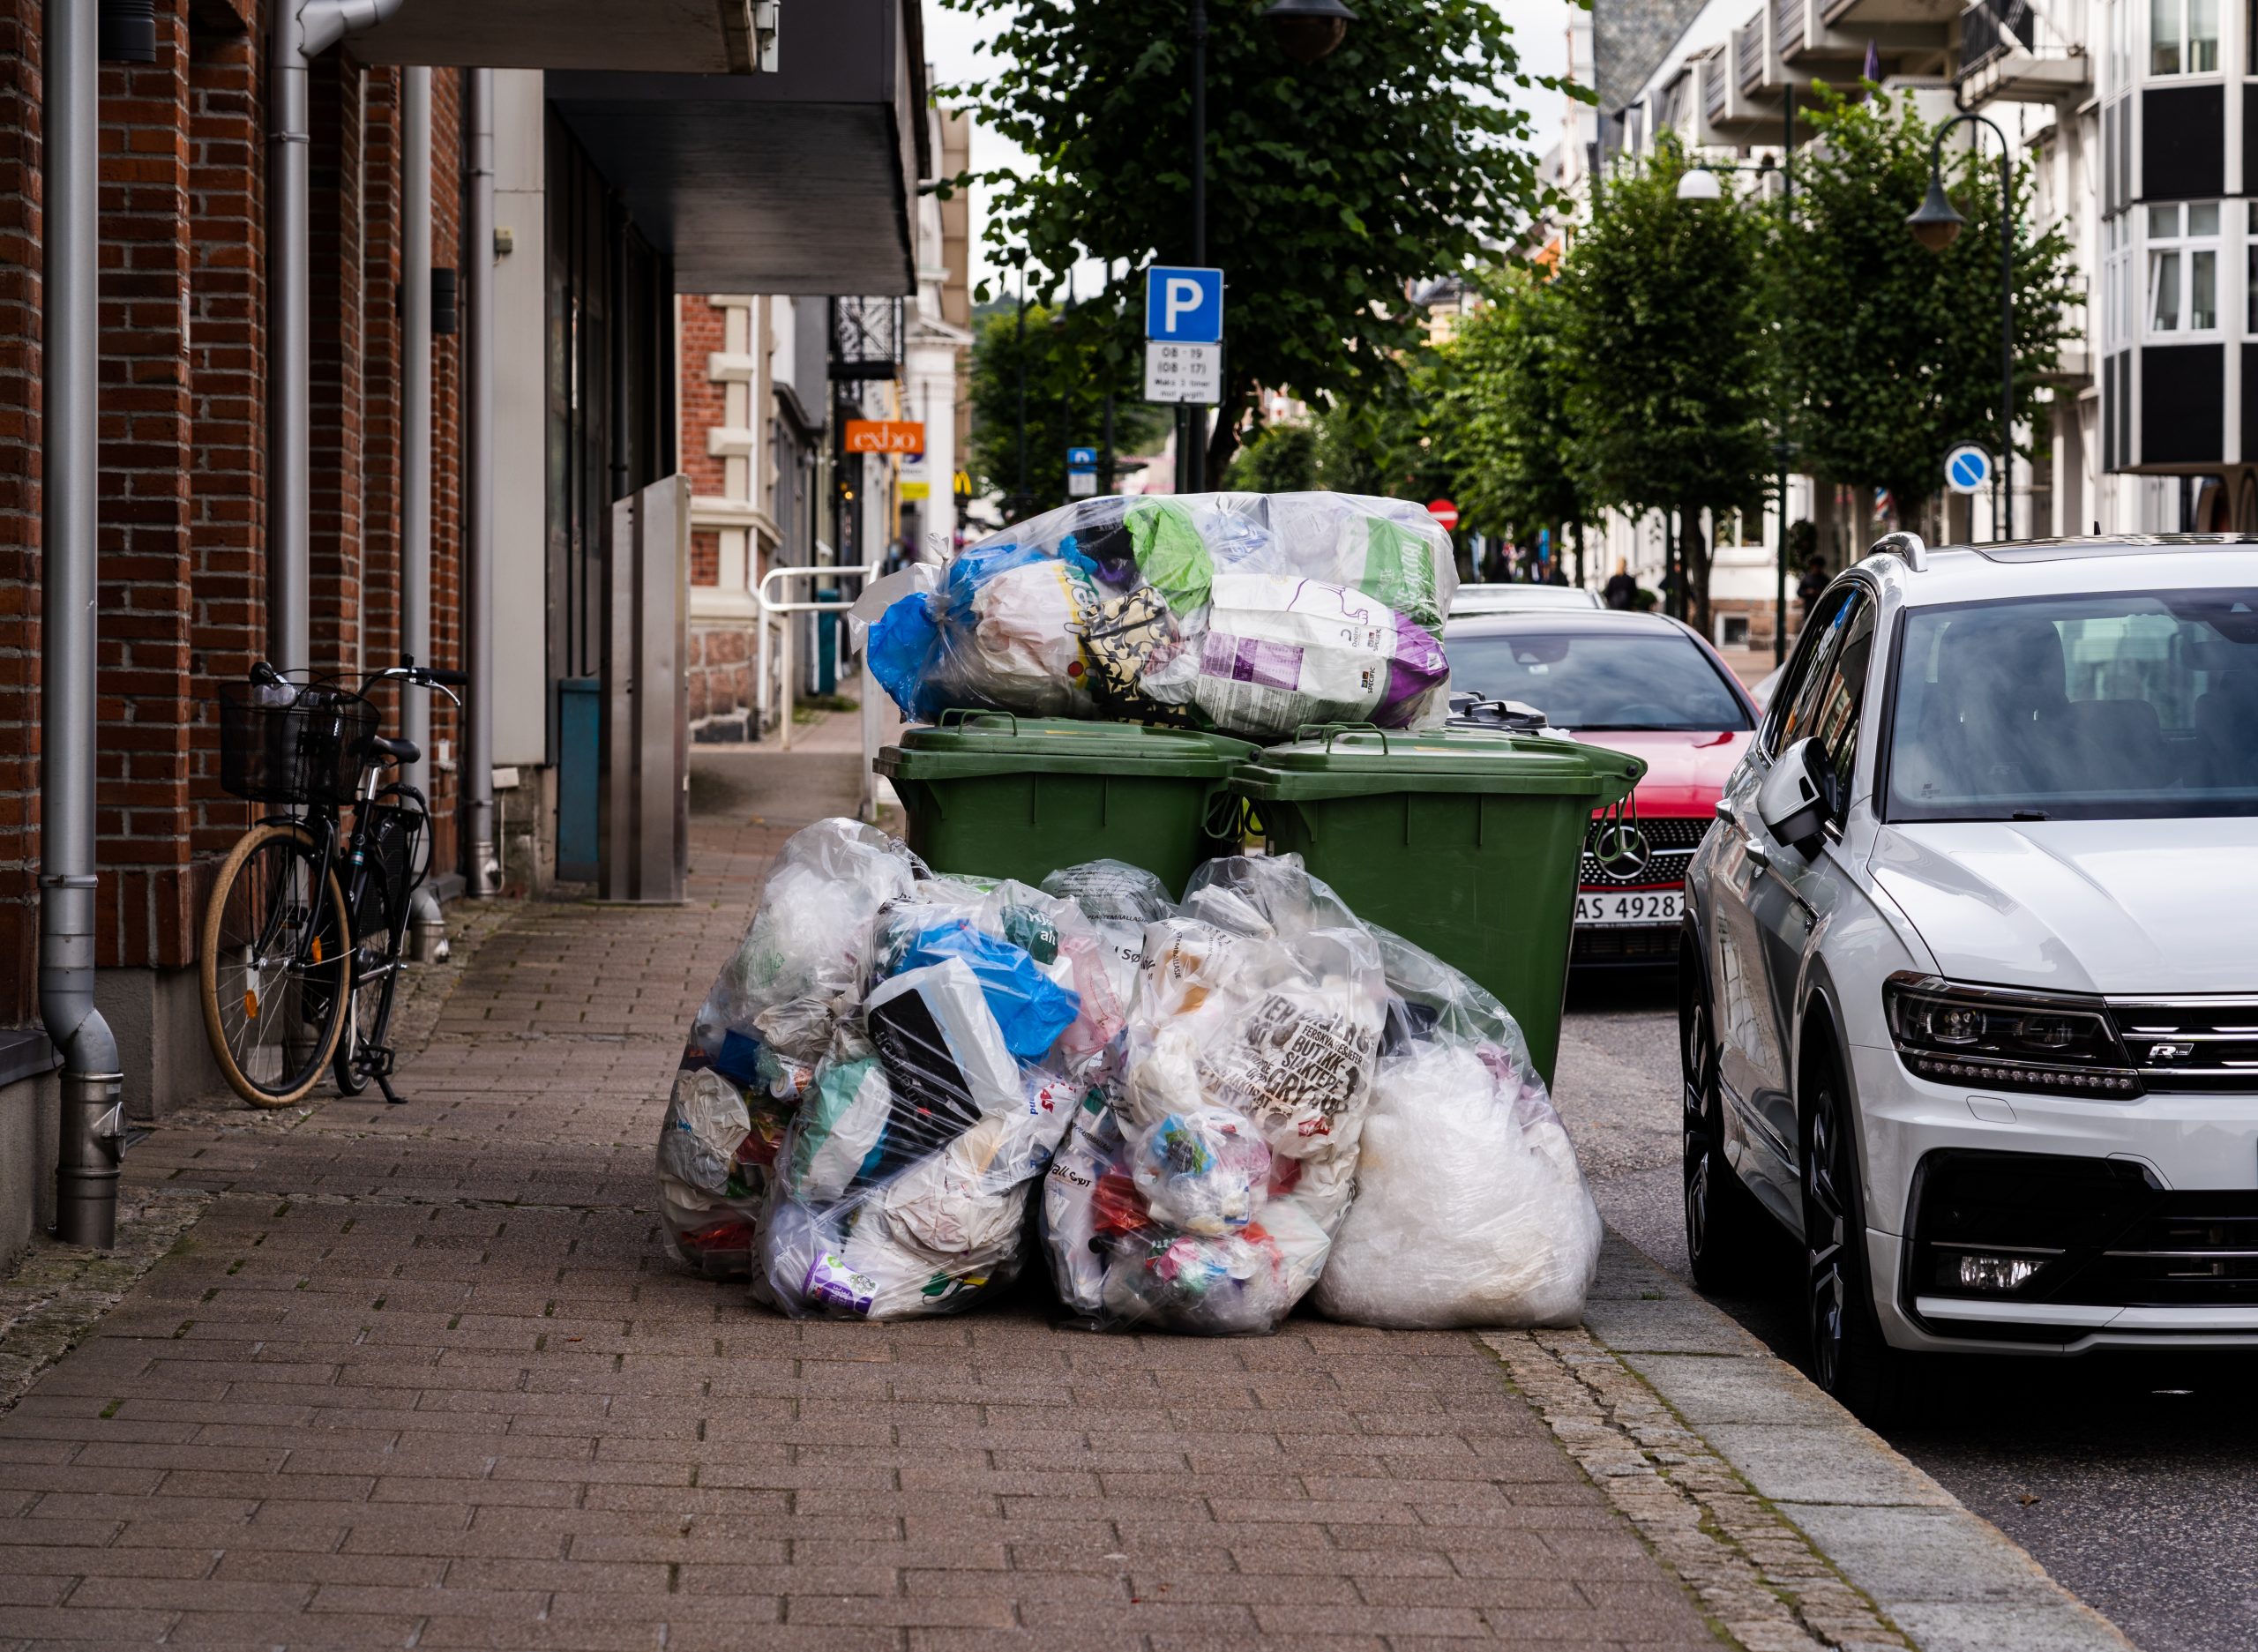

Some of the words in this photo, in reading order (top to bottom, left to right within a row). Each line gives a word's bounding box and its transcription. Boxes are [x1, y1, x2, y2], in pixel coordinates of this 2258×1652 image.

[1165, 278, 1204, 333] P
[1162, 347, 1178, 358] 08
[1576, 898, 1604, 919] AS
[2148, 1046, 2177, 1058] R
